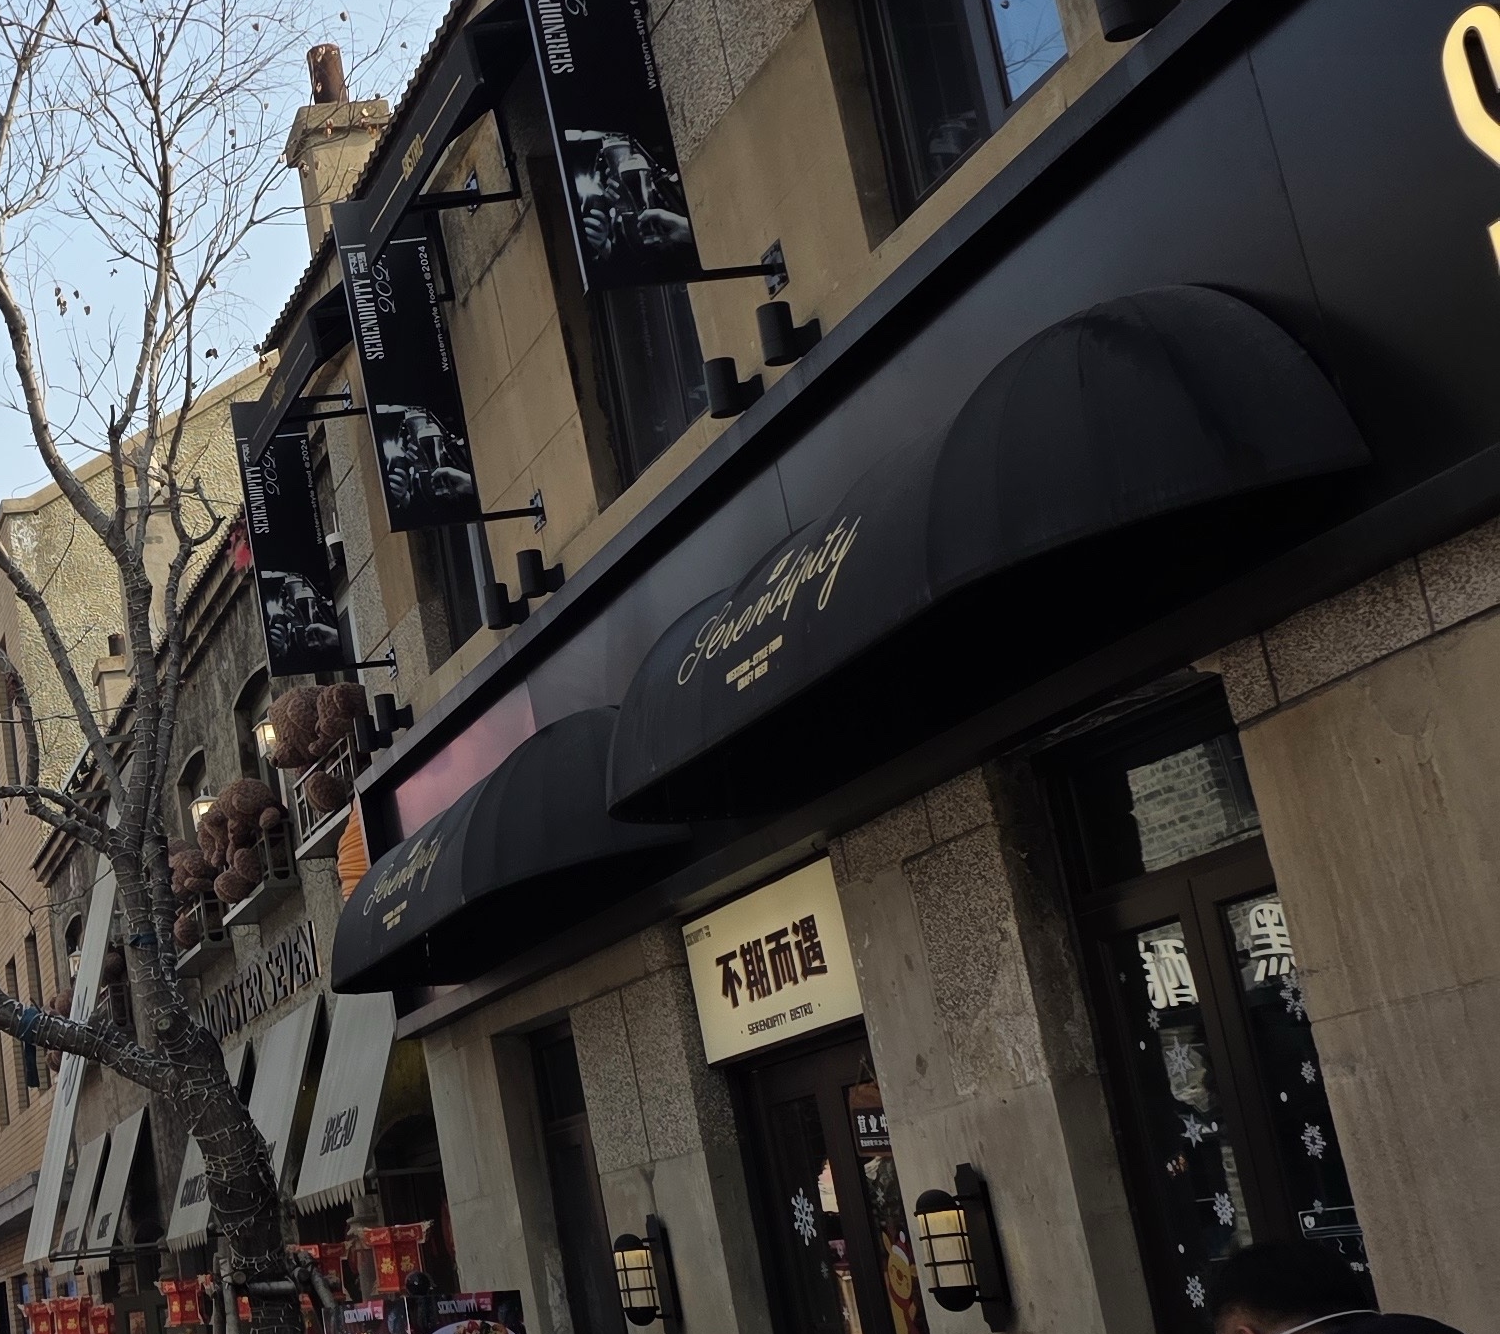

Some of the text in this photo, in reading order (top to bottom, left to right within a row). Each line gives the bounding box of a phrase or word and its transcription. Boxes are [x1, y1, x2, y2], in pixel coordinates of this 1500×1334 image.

[633, 8, 657, 90] Western-style
[352, 279, 384, 360] SERENDIPITY
[426, 282, 437, 304] food
[431, 306, 449, 372] Western-style
[265, 920, 321, 1008] SEVEN
[716, 914, 828, 1008] 不期而遇
[789, 1002, 813, 1021] BISTRO
[320, 1105, 359, 1156] BREAD
